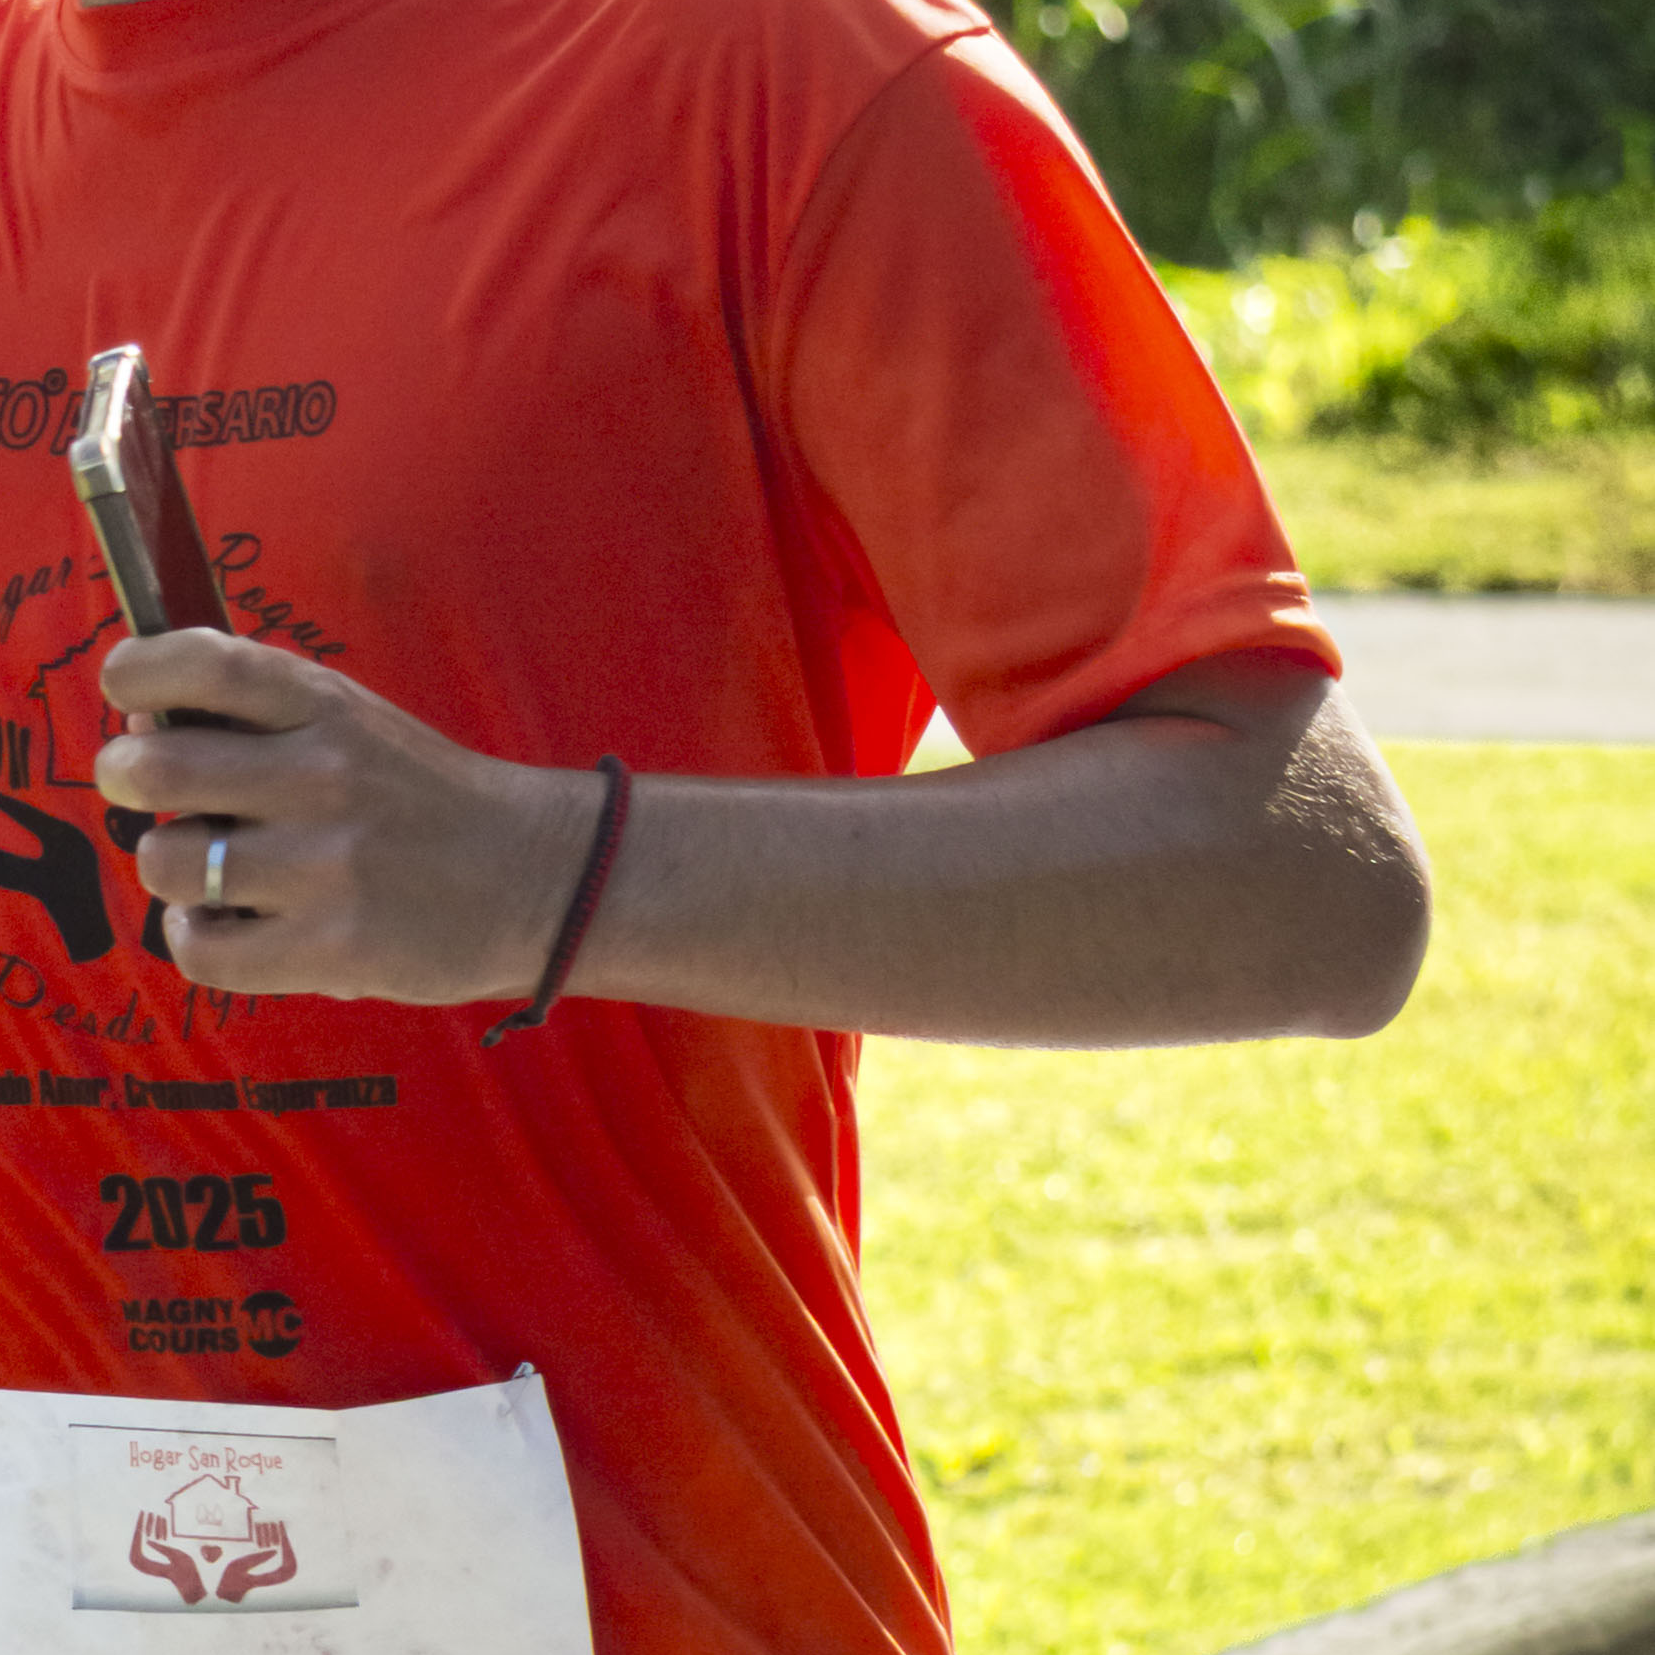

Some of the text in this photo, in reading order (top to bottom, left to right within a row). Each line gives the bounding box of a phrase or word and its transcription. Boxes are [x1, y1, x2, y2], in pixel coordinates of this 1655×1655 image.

[99, 1173, 287, 1253] 2025
[121, 1298, 233, 1324] MAGNY
[242, 1302, 304, 1346] MC
[129, 1326, 241, 1355] COURS
[129, 1441, 283, 1475] Hogar San Roque
